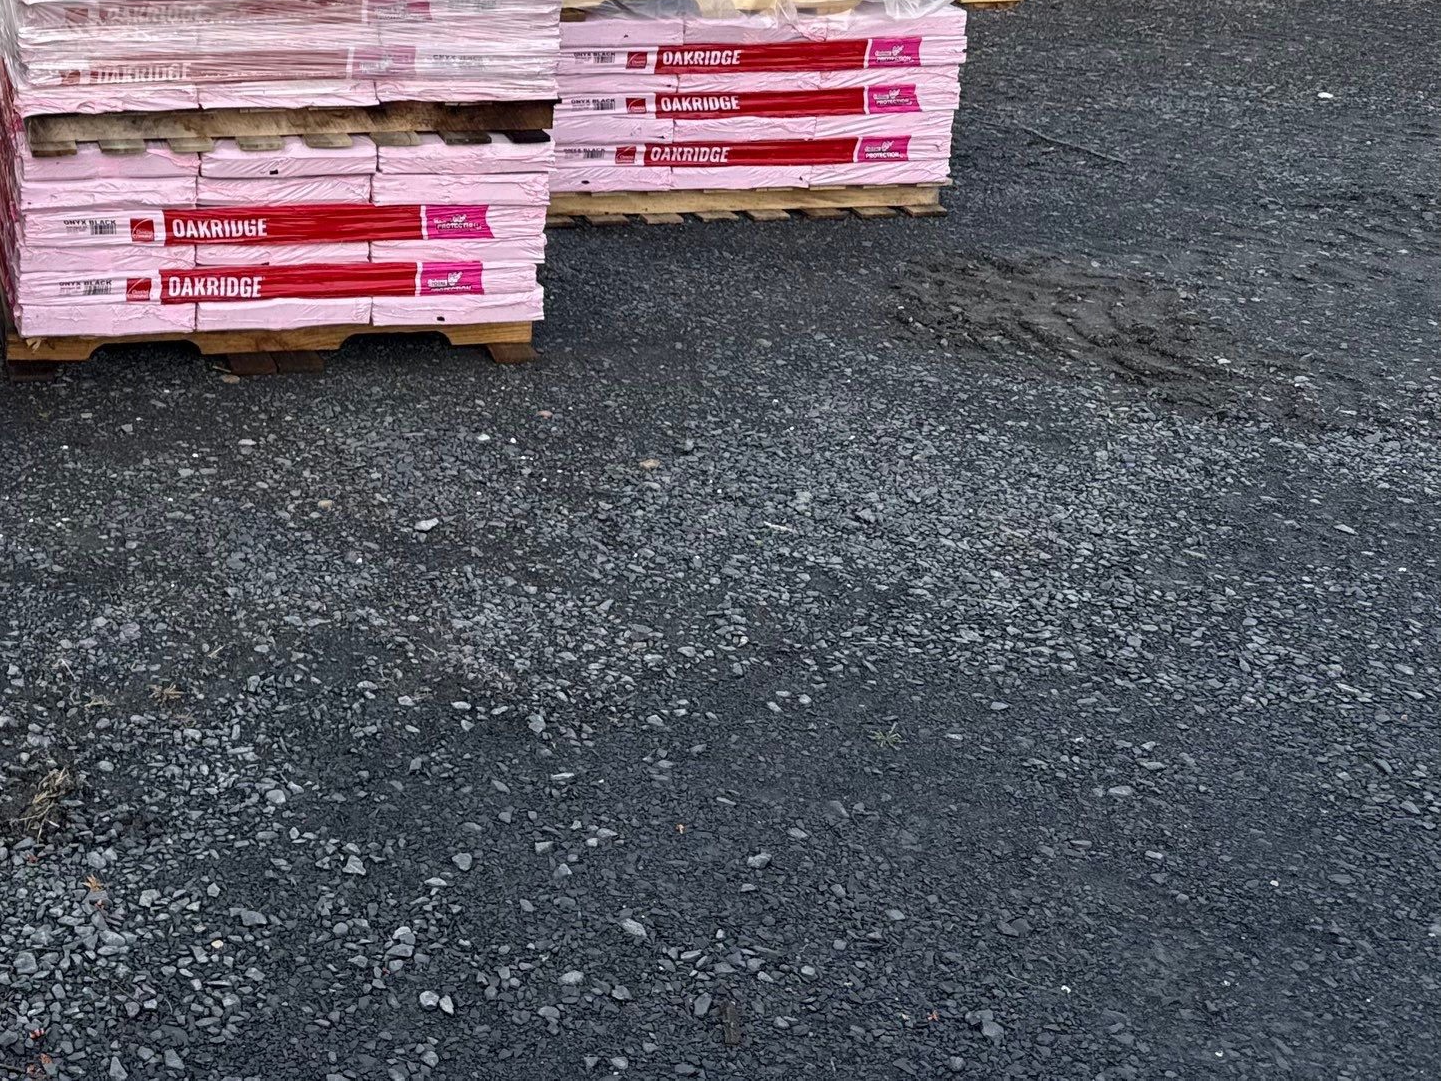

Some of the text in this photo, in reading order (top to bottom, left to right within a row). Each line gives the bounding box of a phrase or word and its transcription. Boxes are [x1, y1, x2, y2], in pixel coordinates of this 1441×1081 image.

[662, 50, 741, 66] OAKRIDGE
[661, 95, 740, 111] OAKRIDGE
[650, 146, 729, 163] OAKRIDGE
[172, 218, 268, 239] OAKRIDGE
[167, 276, 263, 298] OAKRIDGE
